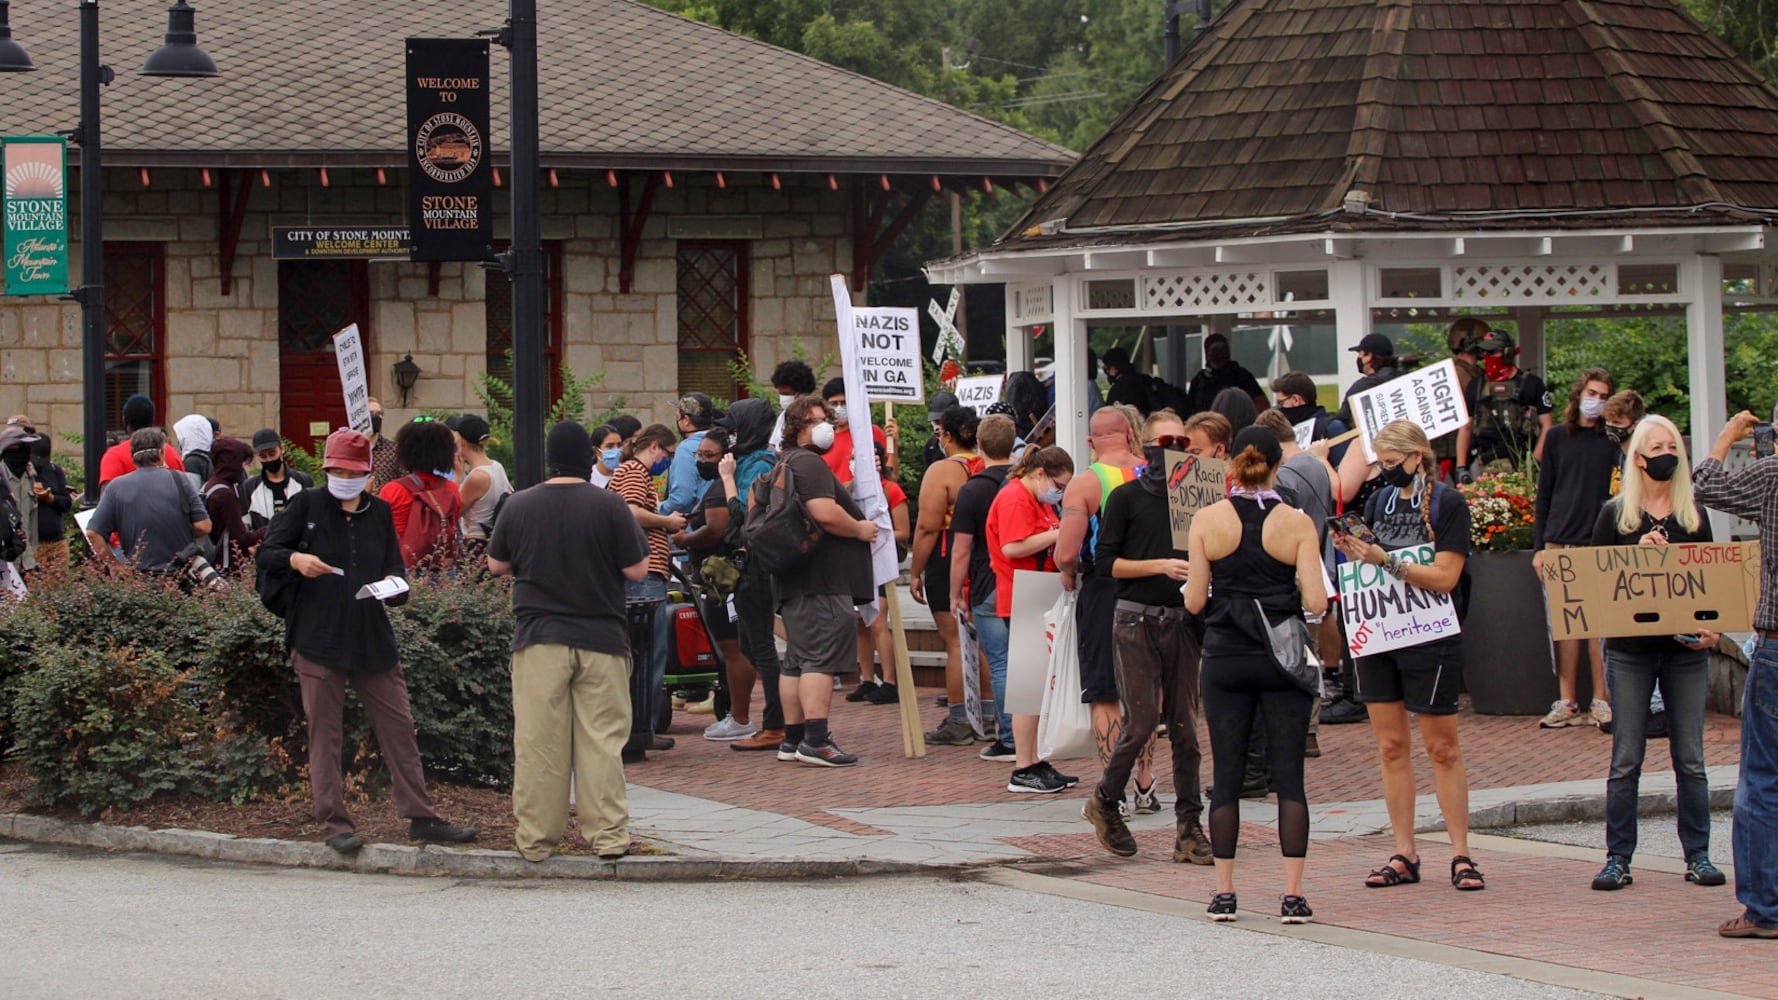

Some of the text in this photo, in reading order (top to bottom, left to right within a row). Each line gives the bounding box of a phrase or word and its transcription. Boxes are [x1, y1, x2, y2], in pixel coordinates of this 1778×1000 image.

[417, 77, 479, 89] WELCOME
[439, 91, 457, 102] TO
[7, 200, 63, 213] STONE
[422, 196, 478, 210] STONE
[7, 213, 63, 222] MOUNTAIN
[423, 210, 477, 219] MOUNTAIN
[7, 221, 64, 231] VILLAGE
[424, 218, 479, 229] VILLAGE
[287, 230, 411, 241] CITY OF STONE MOUNT
[16, 237, 64, 253] Atlanta's
[316, 239, 399, 249] WELCOME CENTER
[7, 253, 58, 269] Mountain
[20, 265, 50, 282] Town
[856, 315, 909, 331] NAZIS
[934, 292, 959, 361] CROSSING
[862, 333, 904, 350] NOT
[862, 369, 907, 383] IN GA
[960, 386, 993, 401] NAZIS
[1428, 367, 1459, 423] FIGHT
[1375, 393, 1389, 426] SUPREM
[1389, 388, 1409, 421] WHI
[1411, 378, 1436, 430] AGAINST
[1595, 544, 1742, 572] UNITY JUSTICE
[1613, 569, 1706, 601] ACTION
[1348, 620, 1374, 656] NOT
